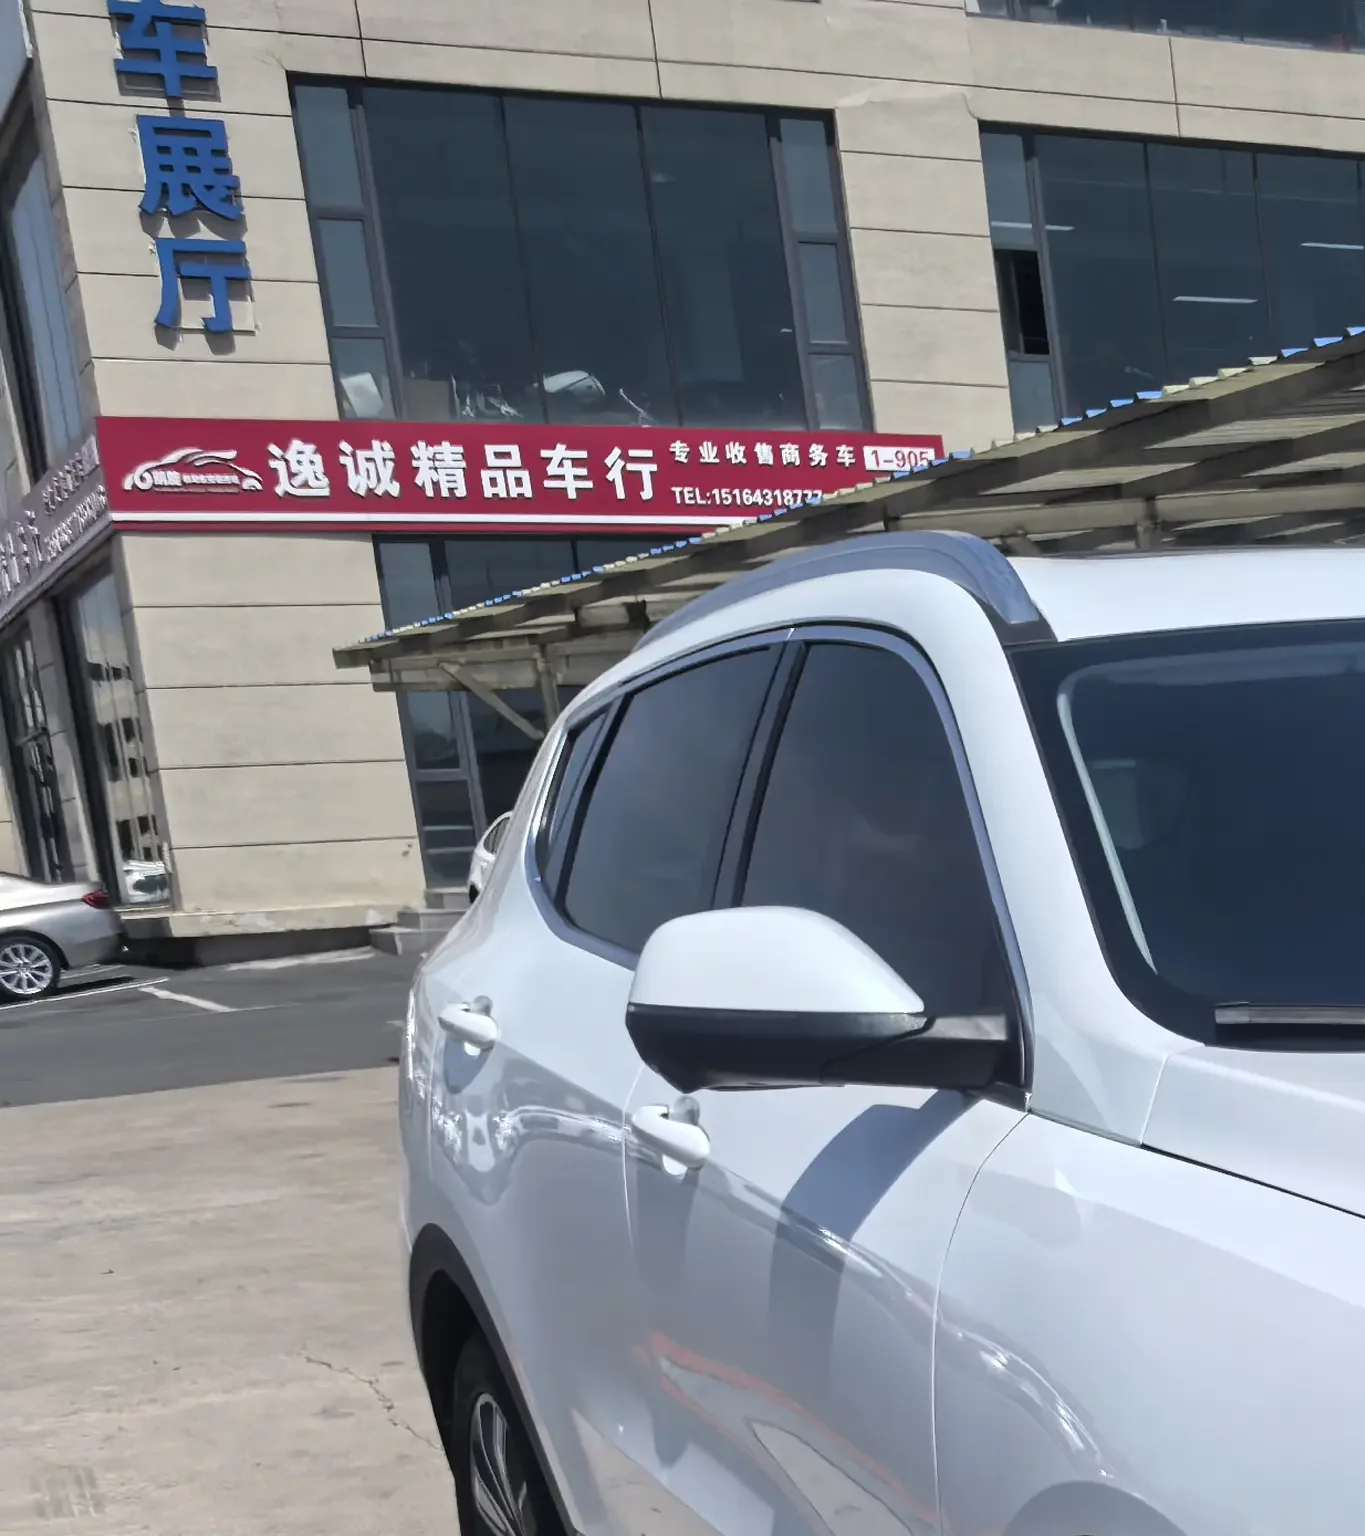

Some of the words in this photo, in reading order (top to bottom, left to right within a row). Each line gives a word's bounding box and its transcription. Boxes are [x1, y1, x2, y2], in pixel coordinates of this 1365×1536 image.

[107, 0, 252, 332] 车展厅
[267, 438, 658, 500] 逸诚精品车行
[669, 440, 856, 467] 专业收售商务车
[870, 449, 930, 469] 1-905
